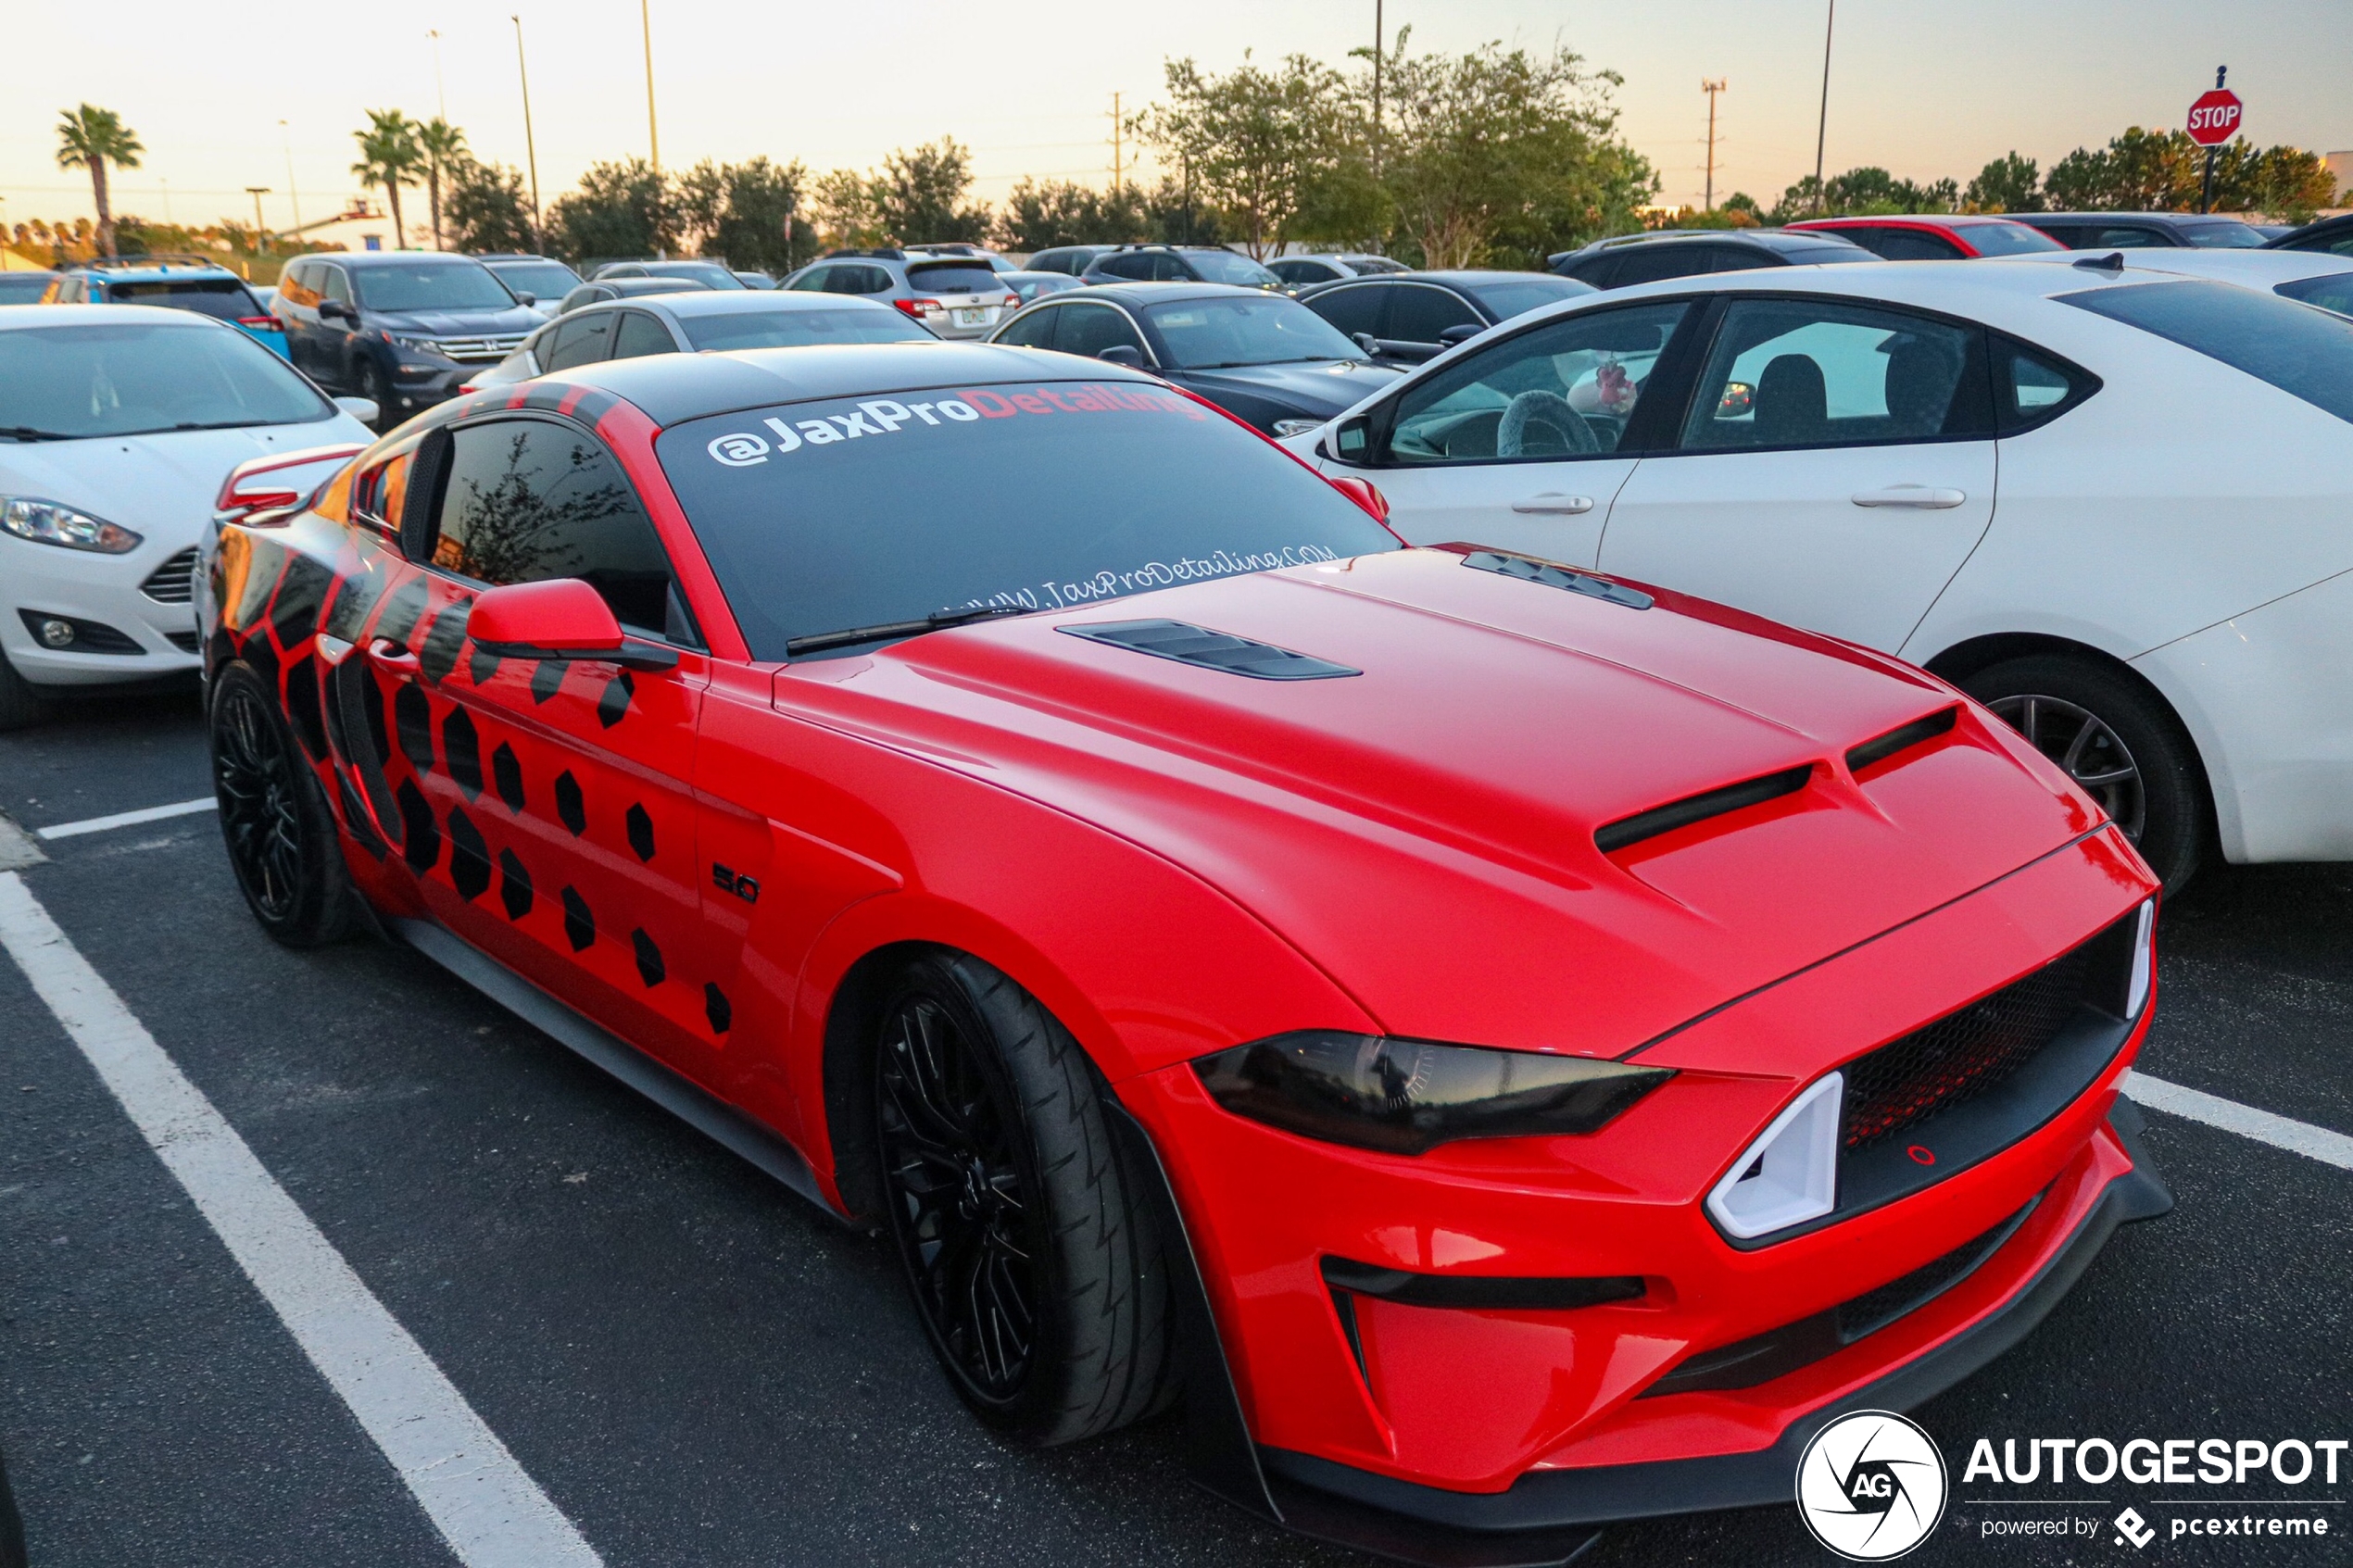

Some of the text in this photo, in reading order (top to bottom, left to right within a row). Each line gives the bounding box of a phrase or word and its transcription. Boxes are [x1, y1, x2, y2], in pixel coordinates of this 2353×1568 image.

[2190, 106, 2239, 130] STOP
[707, 384, 1207, 467] @JaxProDetailing
[943, 544, 1340, 612] W.JaxProDetailing.COM
